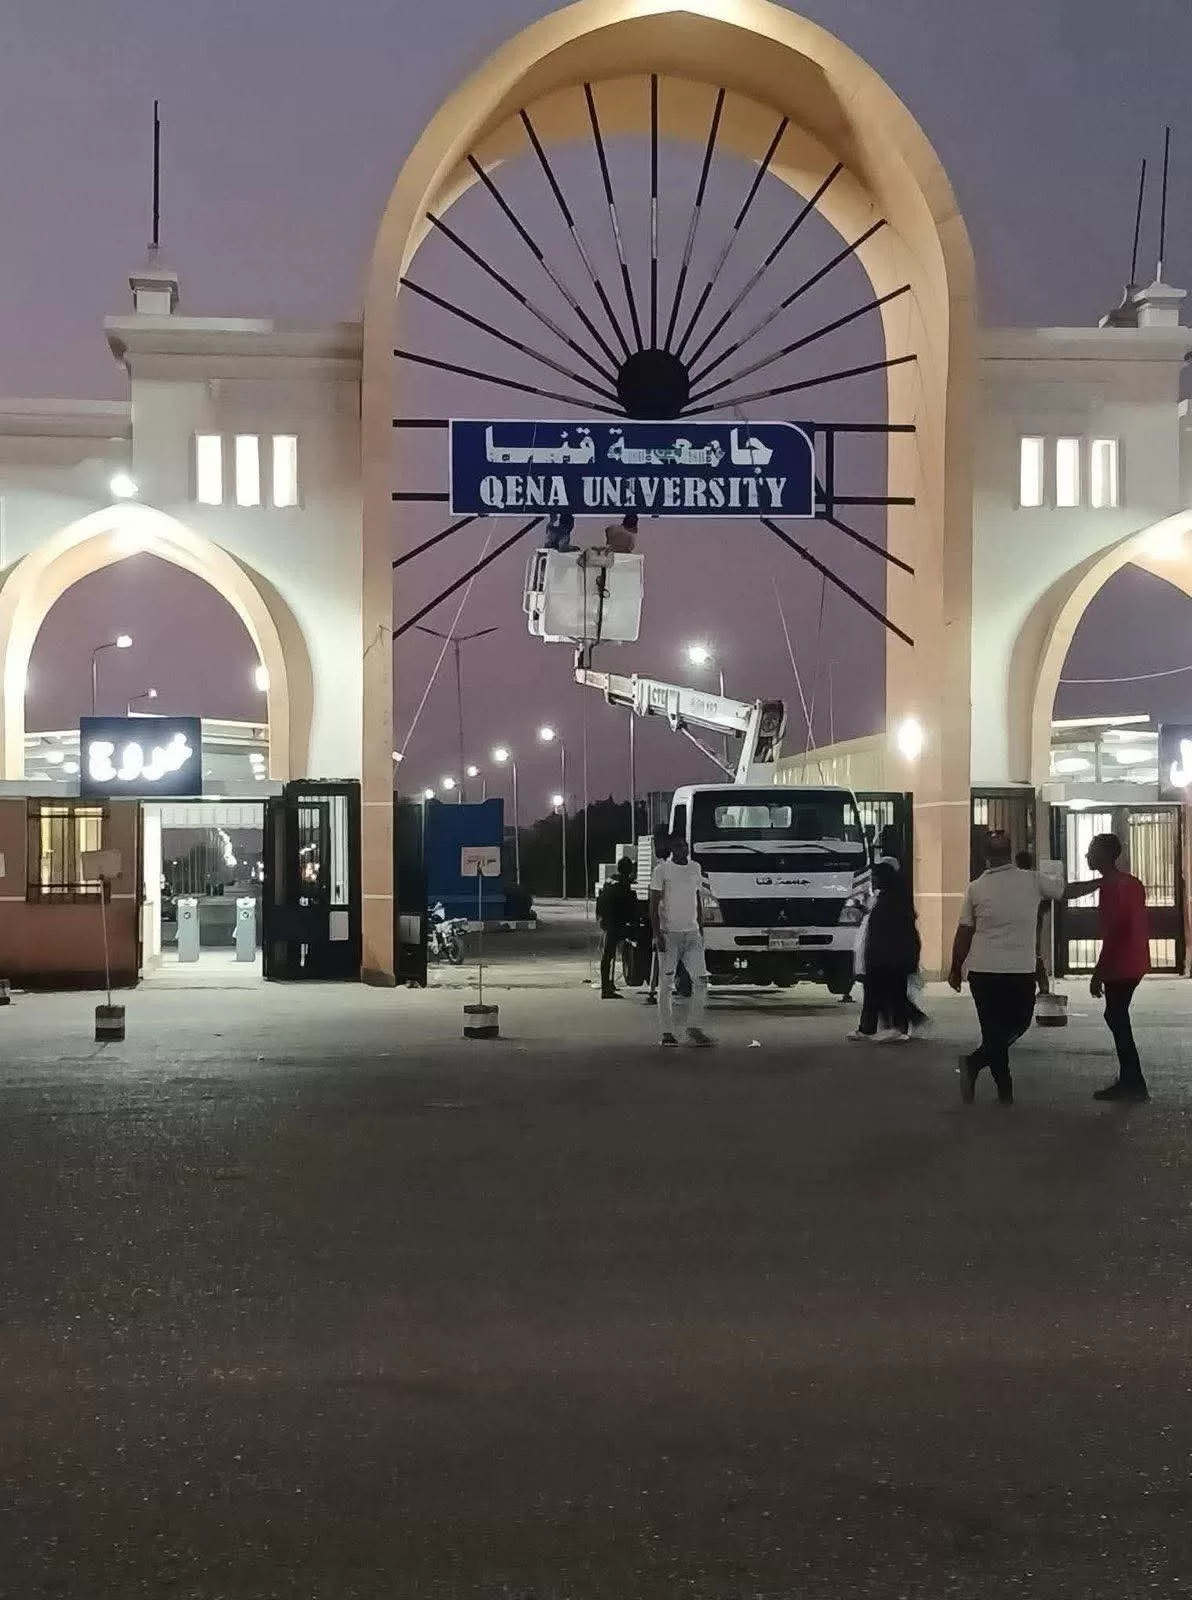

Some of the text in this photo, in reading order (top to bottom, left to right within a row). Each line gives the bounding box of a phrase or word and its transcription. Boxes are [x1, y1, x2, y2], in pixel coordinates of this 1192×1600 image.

[485, 424, 596, 465] قنا
[479, 475, 788, 509] QENA UNIVERSITY
